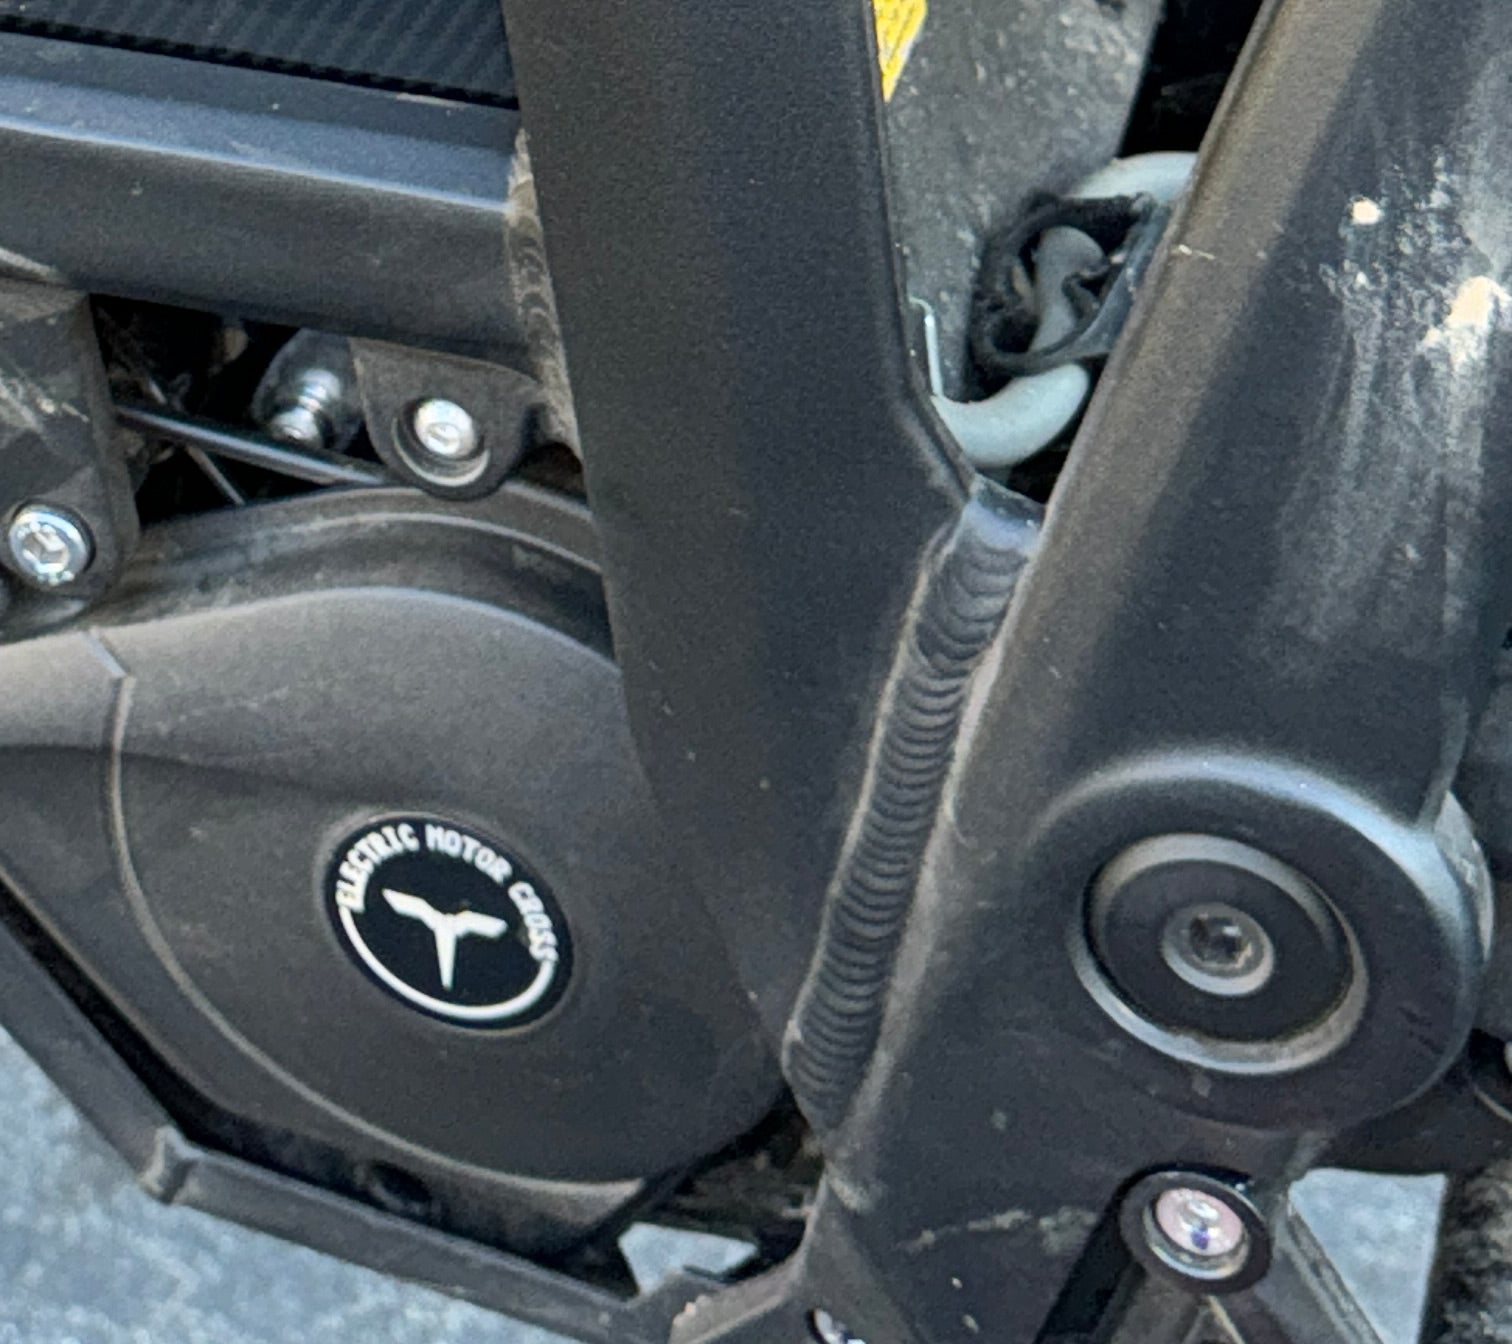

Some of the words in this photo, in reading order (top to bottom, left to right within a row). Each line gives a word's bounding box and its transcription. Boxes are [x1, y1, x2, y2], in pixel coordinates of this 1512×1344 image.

[335, 823, 419, 913] ELECTRIC
[424, 823, 513, 886] MOTOR
[507, 881, 559, 963] CROSS
